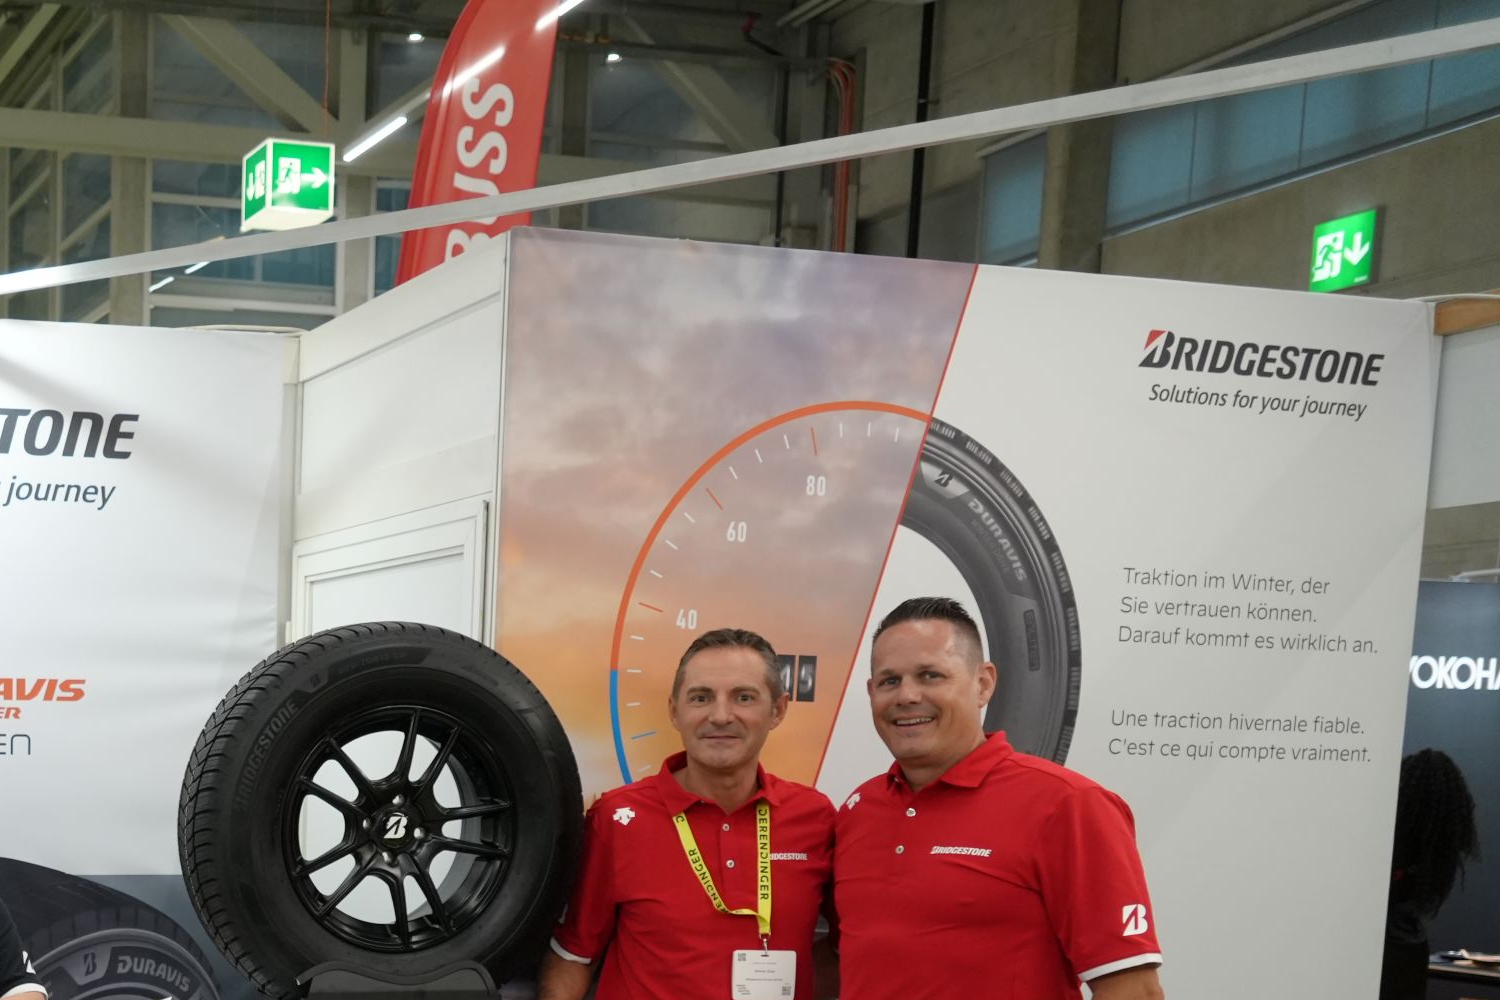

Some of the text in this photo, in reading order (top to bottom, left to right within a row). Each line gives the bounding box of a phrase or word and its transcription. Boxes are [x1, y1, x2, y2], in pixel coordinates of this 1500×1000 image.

[1138, 329, 1386, 387] BRIDGESTONE
[1148, 383, 1368, 422] Solutions for your journey
[2, 475, 116, 511] journey
[806, 476, 826, 496] 80
[726, 522, 747, 543] 60
[967, 497, 1028, 582] DURAVIS
[1122, 566, 1331, 596] Traktion im Winter, der
[676, 609, 698, 629] 40
[1120, 596, 1318, 623] Sie vertrauen können.
[1118, 625, 1379, 654] Darauf kommt es wirklich an.
[1409, 655, 1500, 690] OKOH
[1111, 709, 1365, 735] Une traction hivernale fiable.
[1108, 738, 1372, 764] C'est ce qui compte vraiment.
[758, 808, 770, 900] DERENDINGER
[929, 845, 992, 858] BRIDGESTONE
[116, 955, 192, 992] DURAVIS
